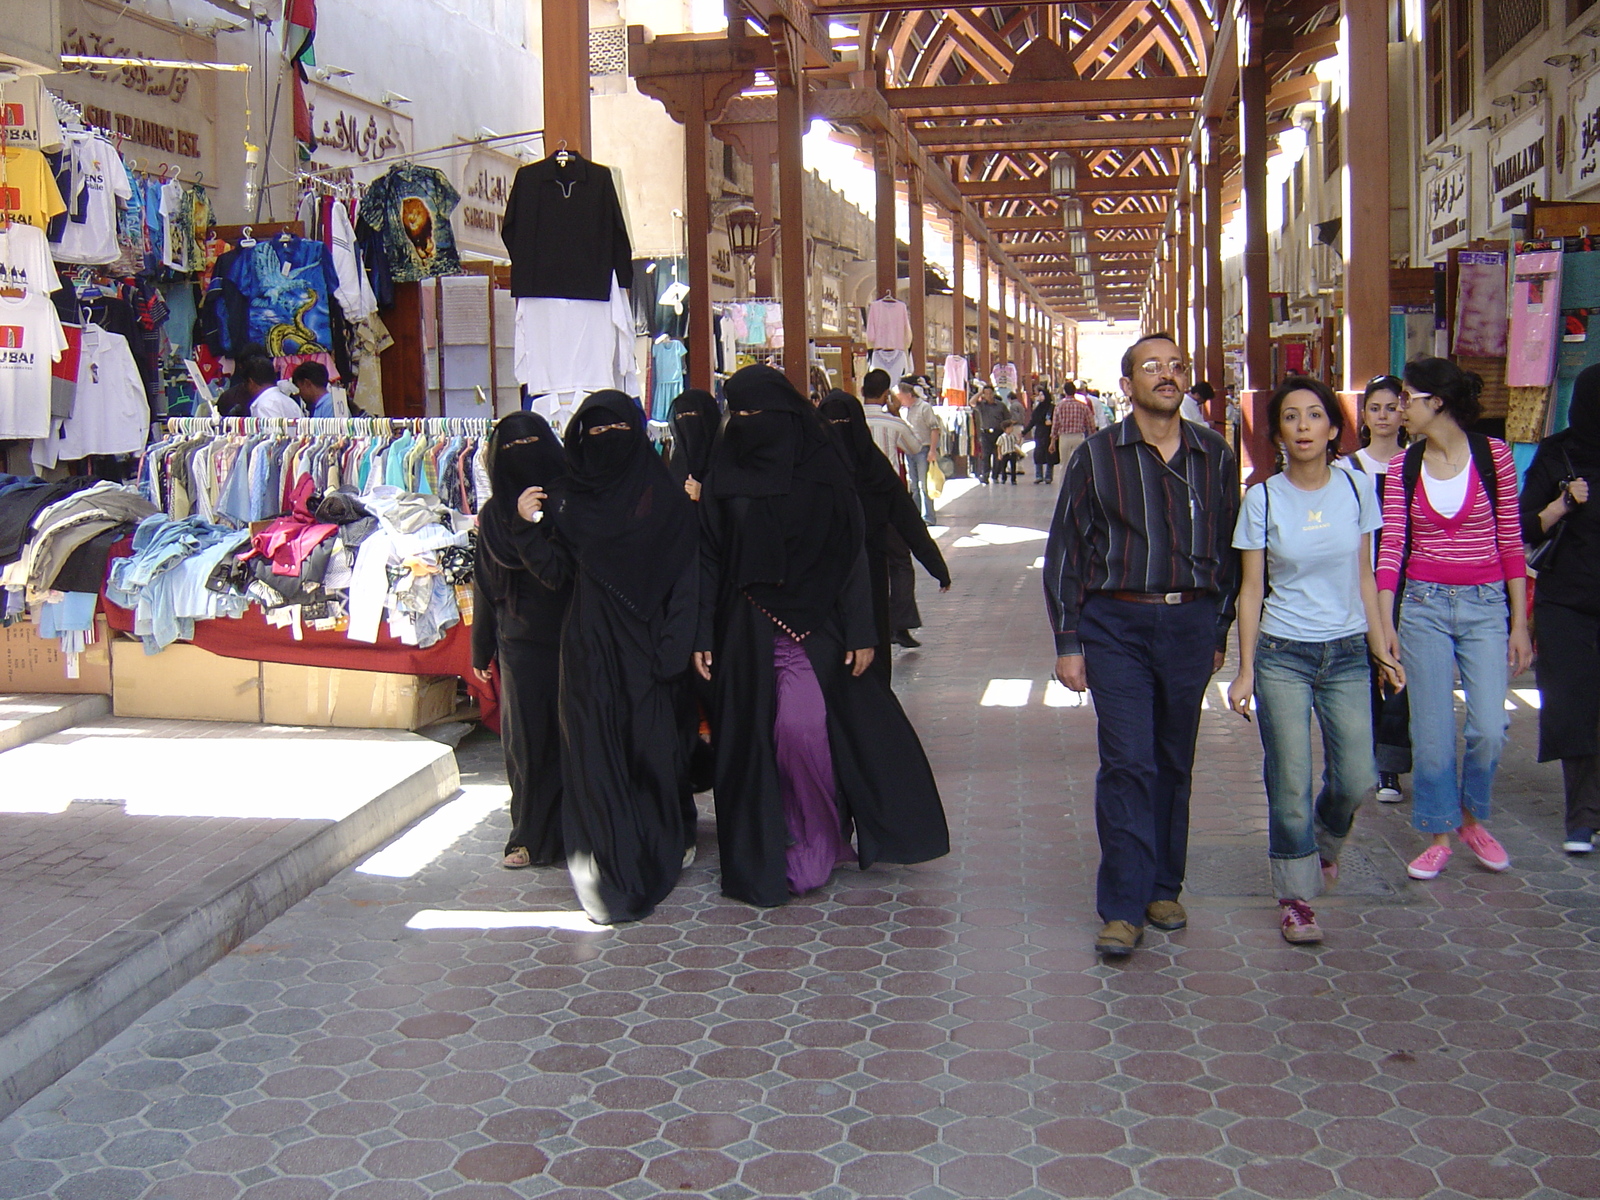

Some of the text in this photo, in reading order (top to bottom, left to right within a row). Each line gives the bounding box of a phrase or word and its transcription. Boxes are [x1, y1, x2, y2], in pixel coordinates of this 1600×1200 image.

[114, 113, 175, 153] TRADING
[177, 129, 201, 158] EST.
[336, 400, 345, 415] 10
